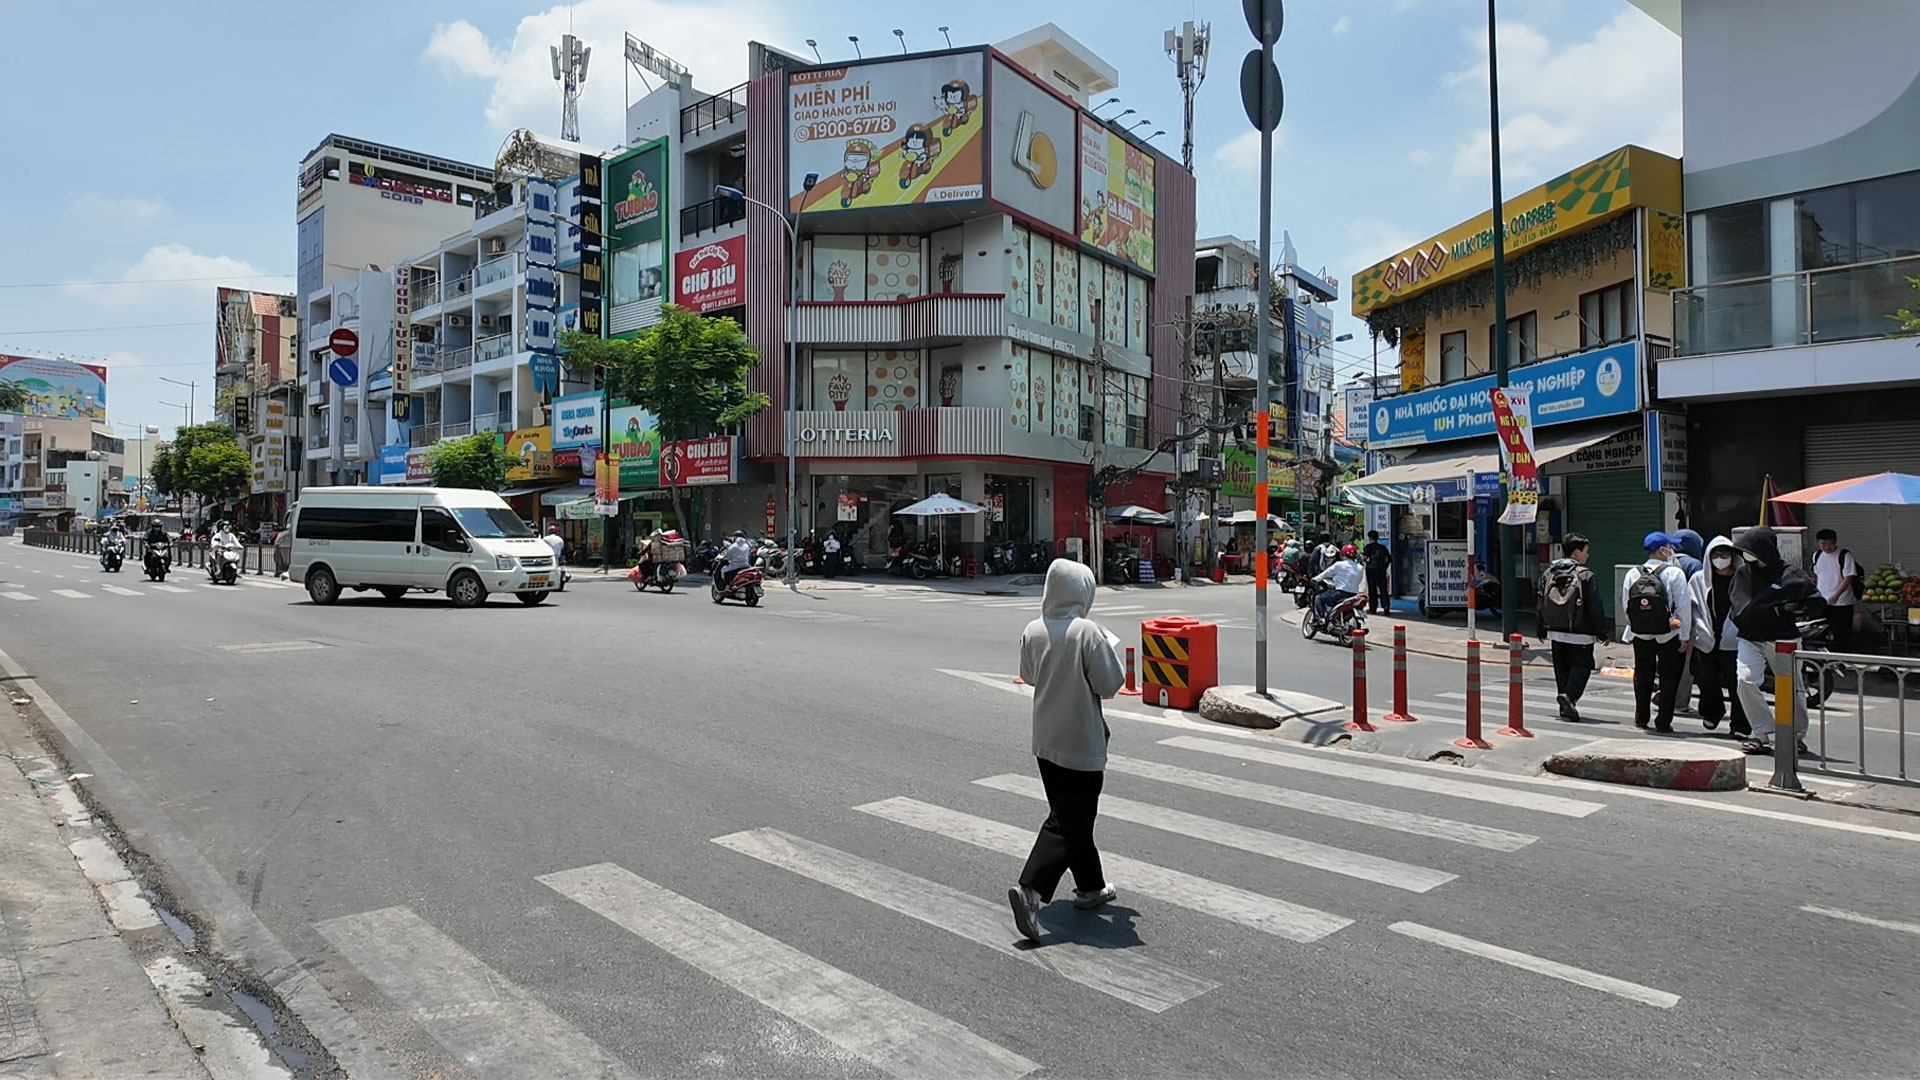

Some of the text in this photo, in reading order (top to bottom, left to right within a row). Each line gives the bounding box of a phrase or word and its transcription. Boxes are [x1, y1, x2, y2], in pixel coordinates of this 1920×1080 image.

[794, 69, 842, 81] LOTTERIA
[794, 81, 871, 108] MIỄN PHÍ
[794, 109, 820, 121] GIAO
[812, 116, 891, 139] 1900-6778
[381, 191, 424, 205] CORP
[940, 188, 980, 199] Delivery
[615, 190, 658, 222] TUIBAO
[1451, 241, 1475, 260] MILK
[1510, 200, 1556, 235] COFFEE
[828, 268, 851, 277] FAVO
[1383, 241, 1449, 291] CARO
[584, 307, 599, 332] VIỆT
[396, 354, 408, 391] FULL
[535, 365, 555, 373] KHOA
[828, 382, 851, 391] FAVO
[1395, 402, 1414, 420] NHÀ
[1415, 395, 1448, 416] THUỐC
[1449, 392, 1467, 412] ĐẠI
[1537, 366, 1585, 394] NGHIỆP
[1510, 397, 1526, 405] XVI
[1434, 415, 1455, 432] IUH
[794, 427, 893, 442] OTTERIA
[1510, 430, 1520, 445] ỦA
[612, 440, 652, 462] TUIBAO
[1576, 444, 1642, 463] CÔNG NGHIỆP
[1434, 557, 1466, 568] NHÀ THUỐC
[1439, 570, 1461, 580] ĐẠI HỌC
[1432, 580, 1446, 590] CÔNG
